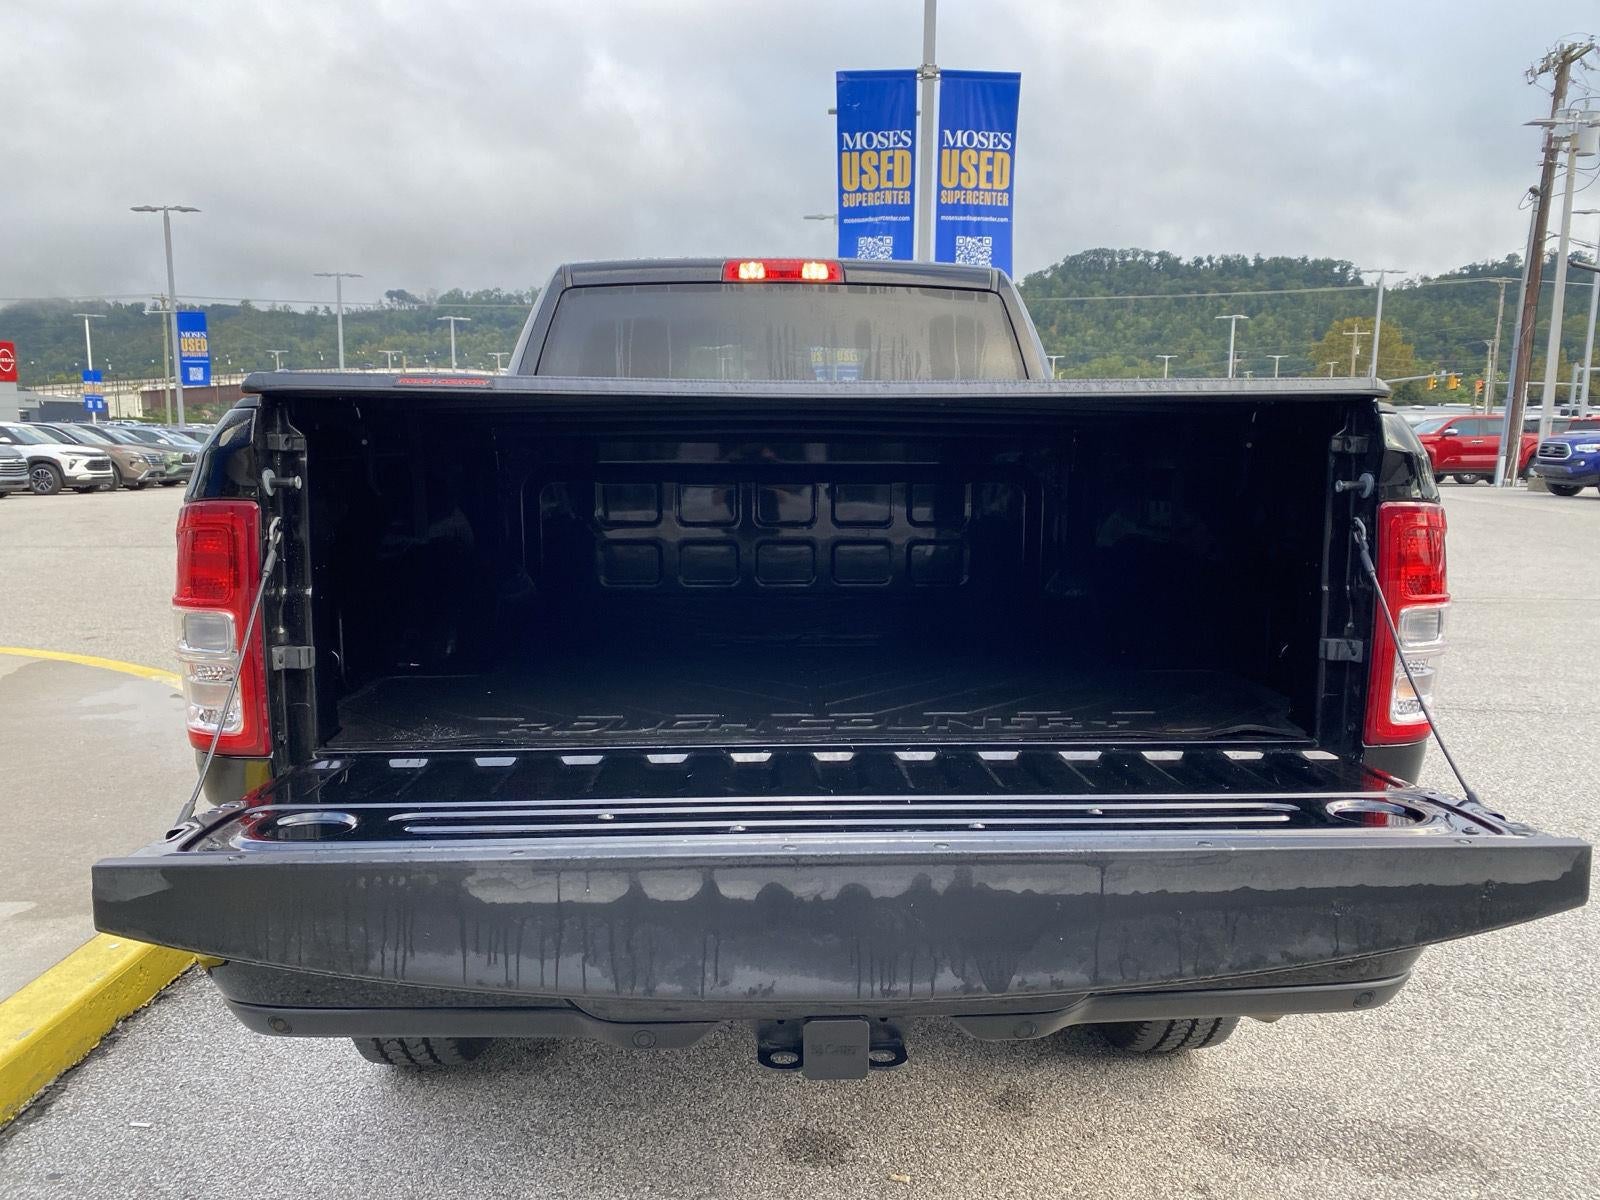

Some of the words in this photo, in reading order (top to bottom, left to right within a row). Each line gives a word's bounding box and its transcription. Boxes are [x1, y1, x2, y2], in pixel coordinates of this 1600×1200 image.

[842, 130, 912, 150] MOSES
[943, 130, 1012, 149] MOSES
[842, 149, 912, 191] USED
[941, 149, 1011, 190] USED
[842, 190, 911, 208] SUPERCENTER
[940, 190, 1009, 206] SUPERCENTER
[181, 338, 208, 352] USED
